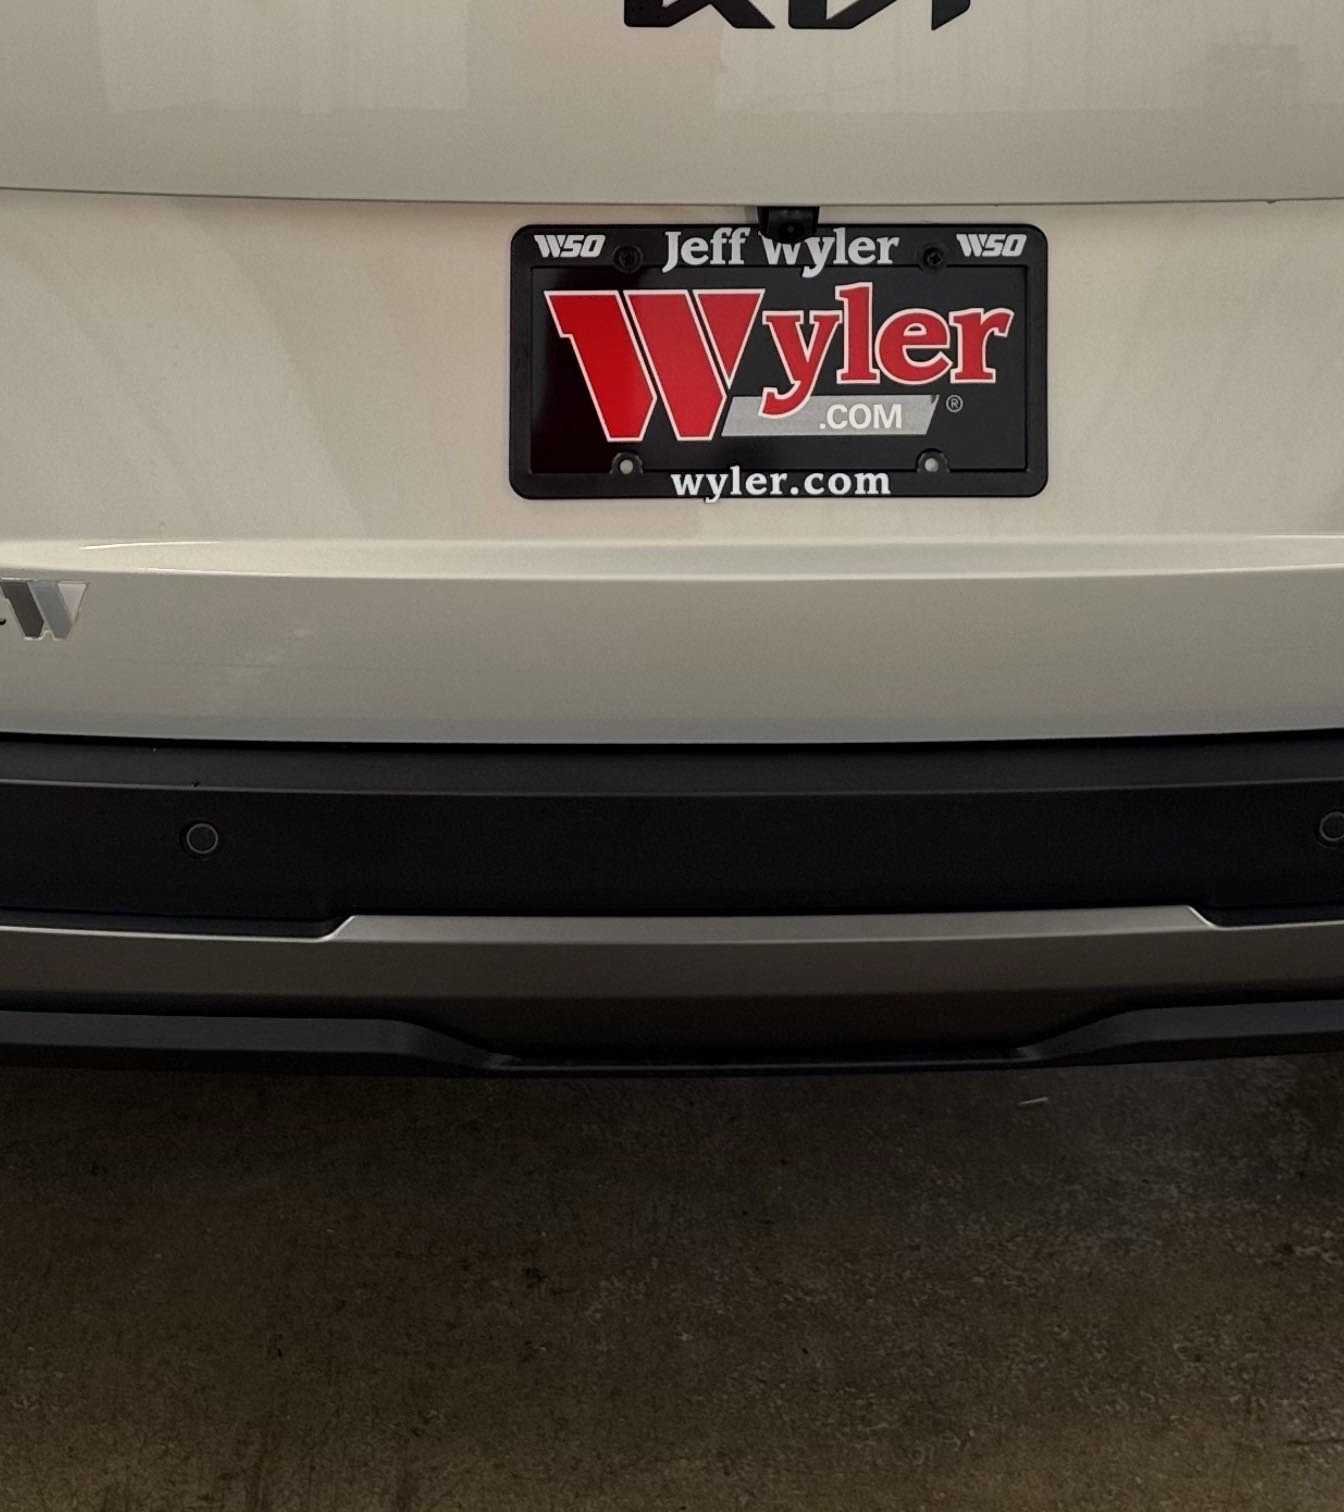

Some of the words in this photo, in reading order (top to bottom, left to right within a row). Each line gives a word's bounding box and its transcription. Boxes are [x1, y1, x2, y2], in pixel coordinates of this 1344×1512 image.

[661, 226, 751, 273] Jeff
[757, 226, 900, 278] Wyler
[544, 282, 1015, 442] Wyler
[819, 403, 903, 430] .COM
[671, 465, 892, 504] wyler.com
